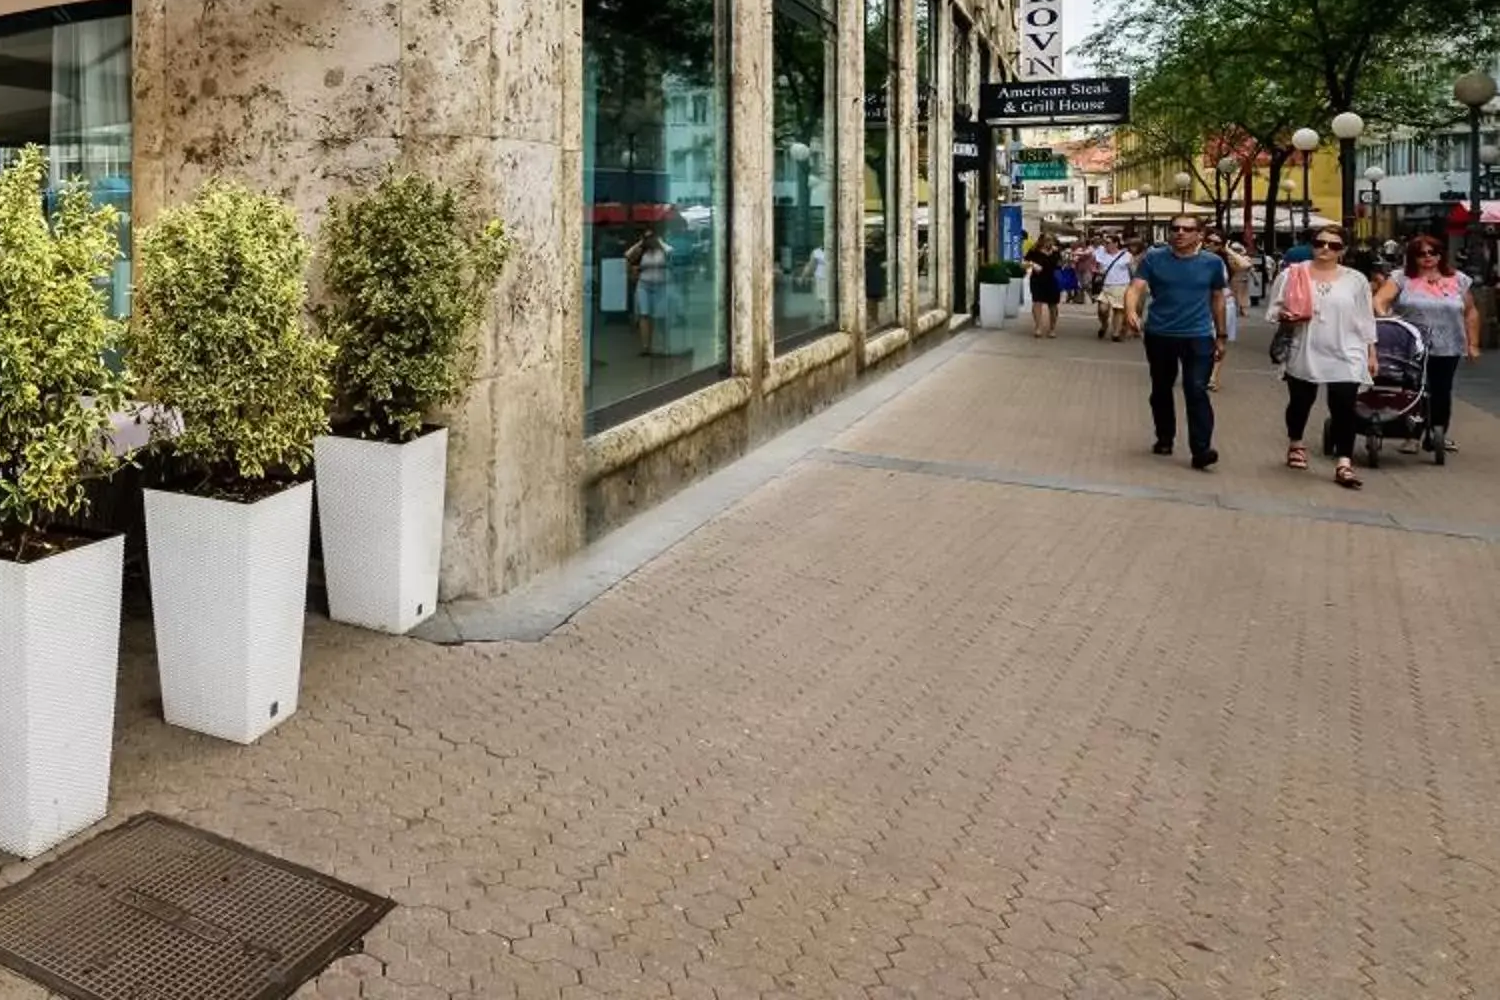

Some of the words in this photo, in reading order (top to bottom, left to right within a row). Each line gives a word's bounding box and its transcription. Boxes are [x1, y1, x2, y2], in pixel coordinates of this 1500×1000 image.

[998, 84, 1067, 98] American
[1070, 81, 1112, 96] Steak
[1003, 101, 1017, 114] &
[1020, 99, 1054, 113] Grill
[1058, 98, 1106, 112] House
